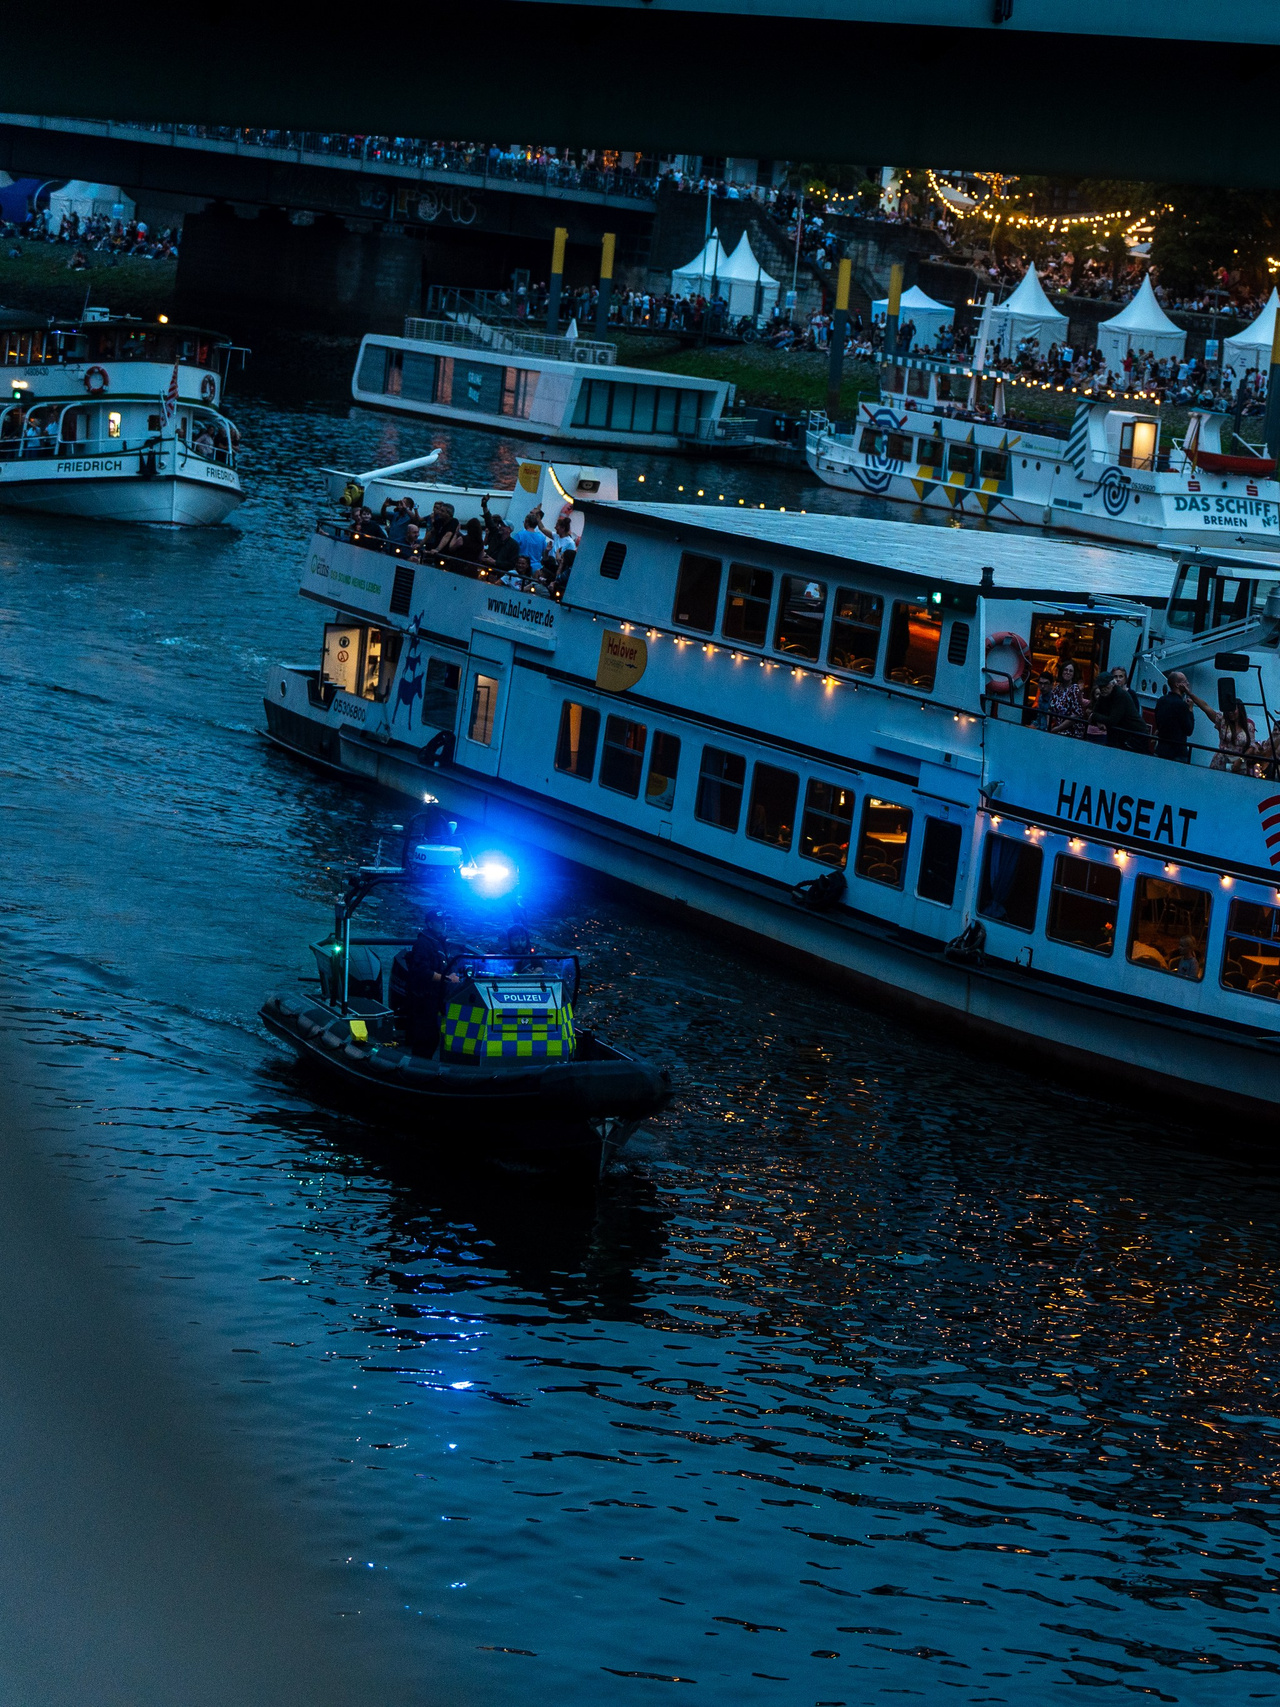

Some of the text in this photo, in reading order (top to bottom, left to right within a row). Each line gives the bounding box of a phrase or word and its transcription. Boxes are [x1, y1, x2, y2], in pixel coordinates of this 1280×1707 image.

[57, 460, 122, 473] FRIEDRICH
[206, 466, 236, 482] FRIEDRICH
[1174, 496, 1271, 517] DAS SCHIFF
[1203, 515, 1248, 527] BREMEN
[488, 597, 554, 628] www.hal-oever.de
[1056, 779, 1198, 847] HANSEAT
[503, 994, 542, 1002] POLIZEI
